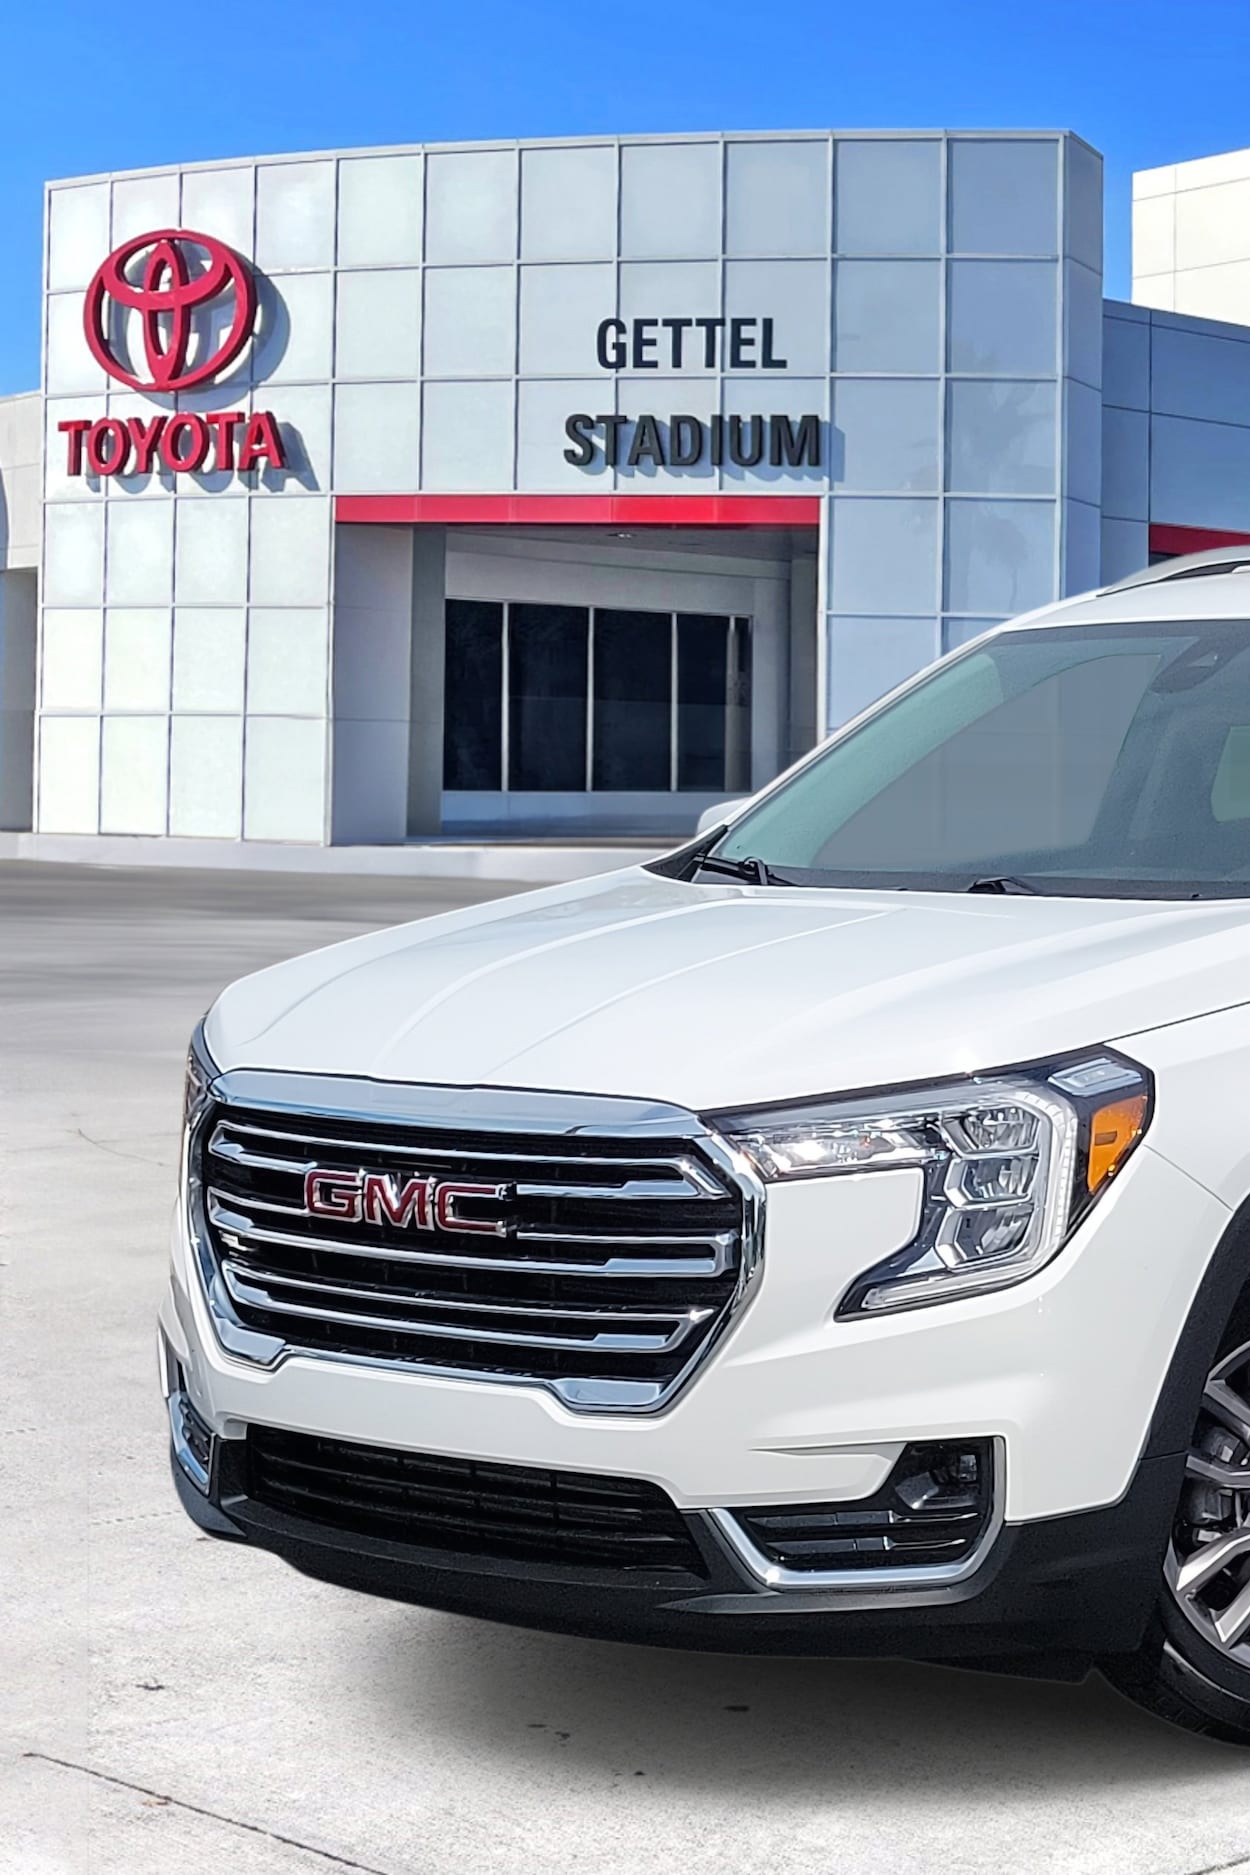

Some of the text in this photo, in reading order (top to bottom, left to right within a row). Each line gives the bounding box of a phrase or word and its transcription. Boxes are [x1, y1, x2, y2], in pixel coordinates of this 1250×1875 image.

[596, 318, 787, 369] GETTEL
[58, 411, 285, 477] TOYOTA
[563, 414, 820, 467] STADIUM
[304, 1168, 507, 1239] GMC
